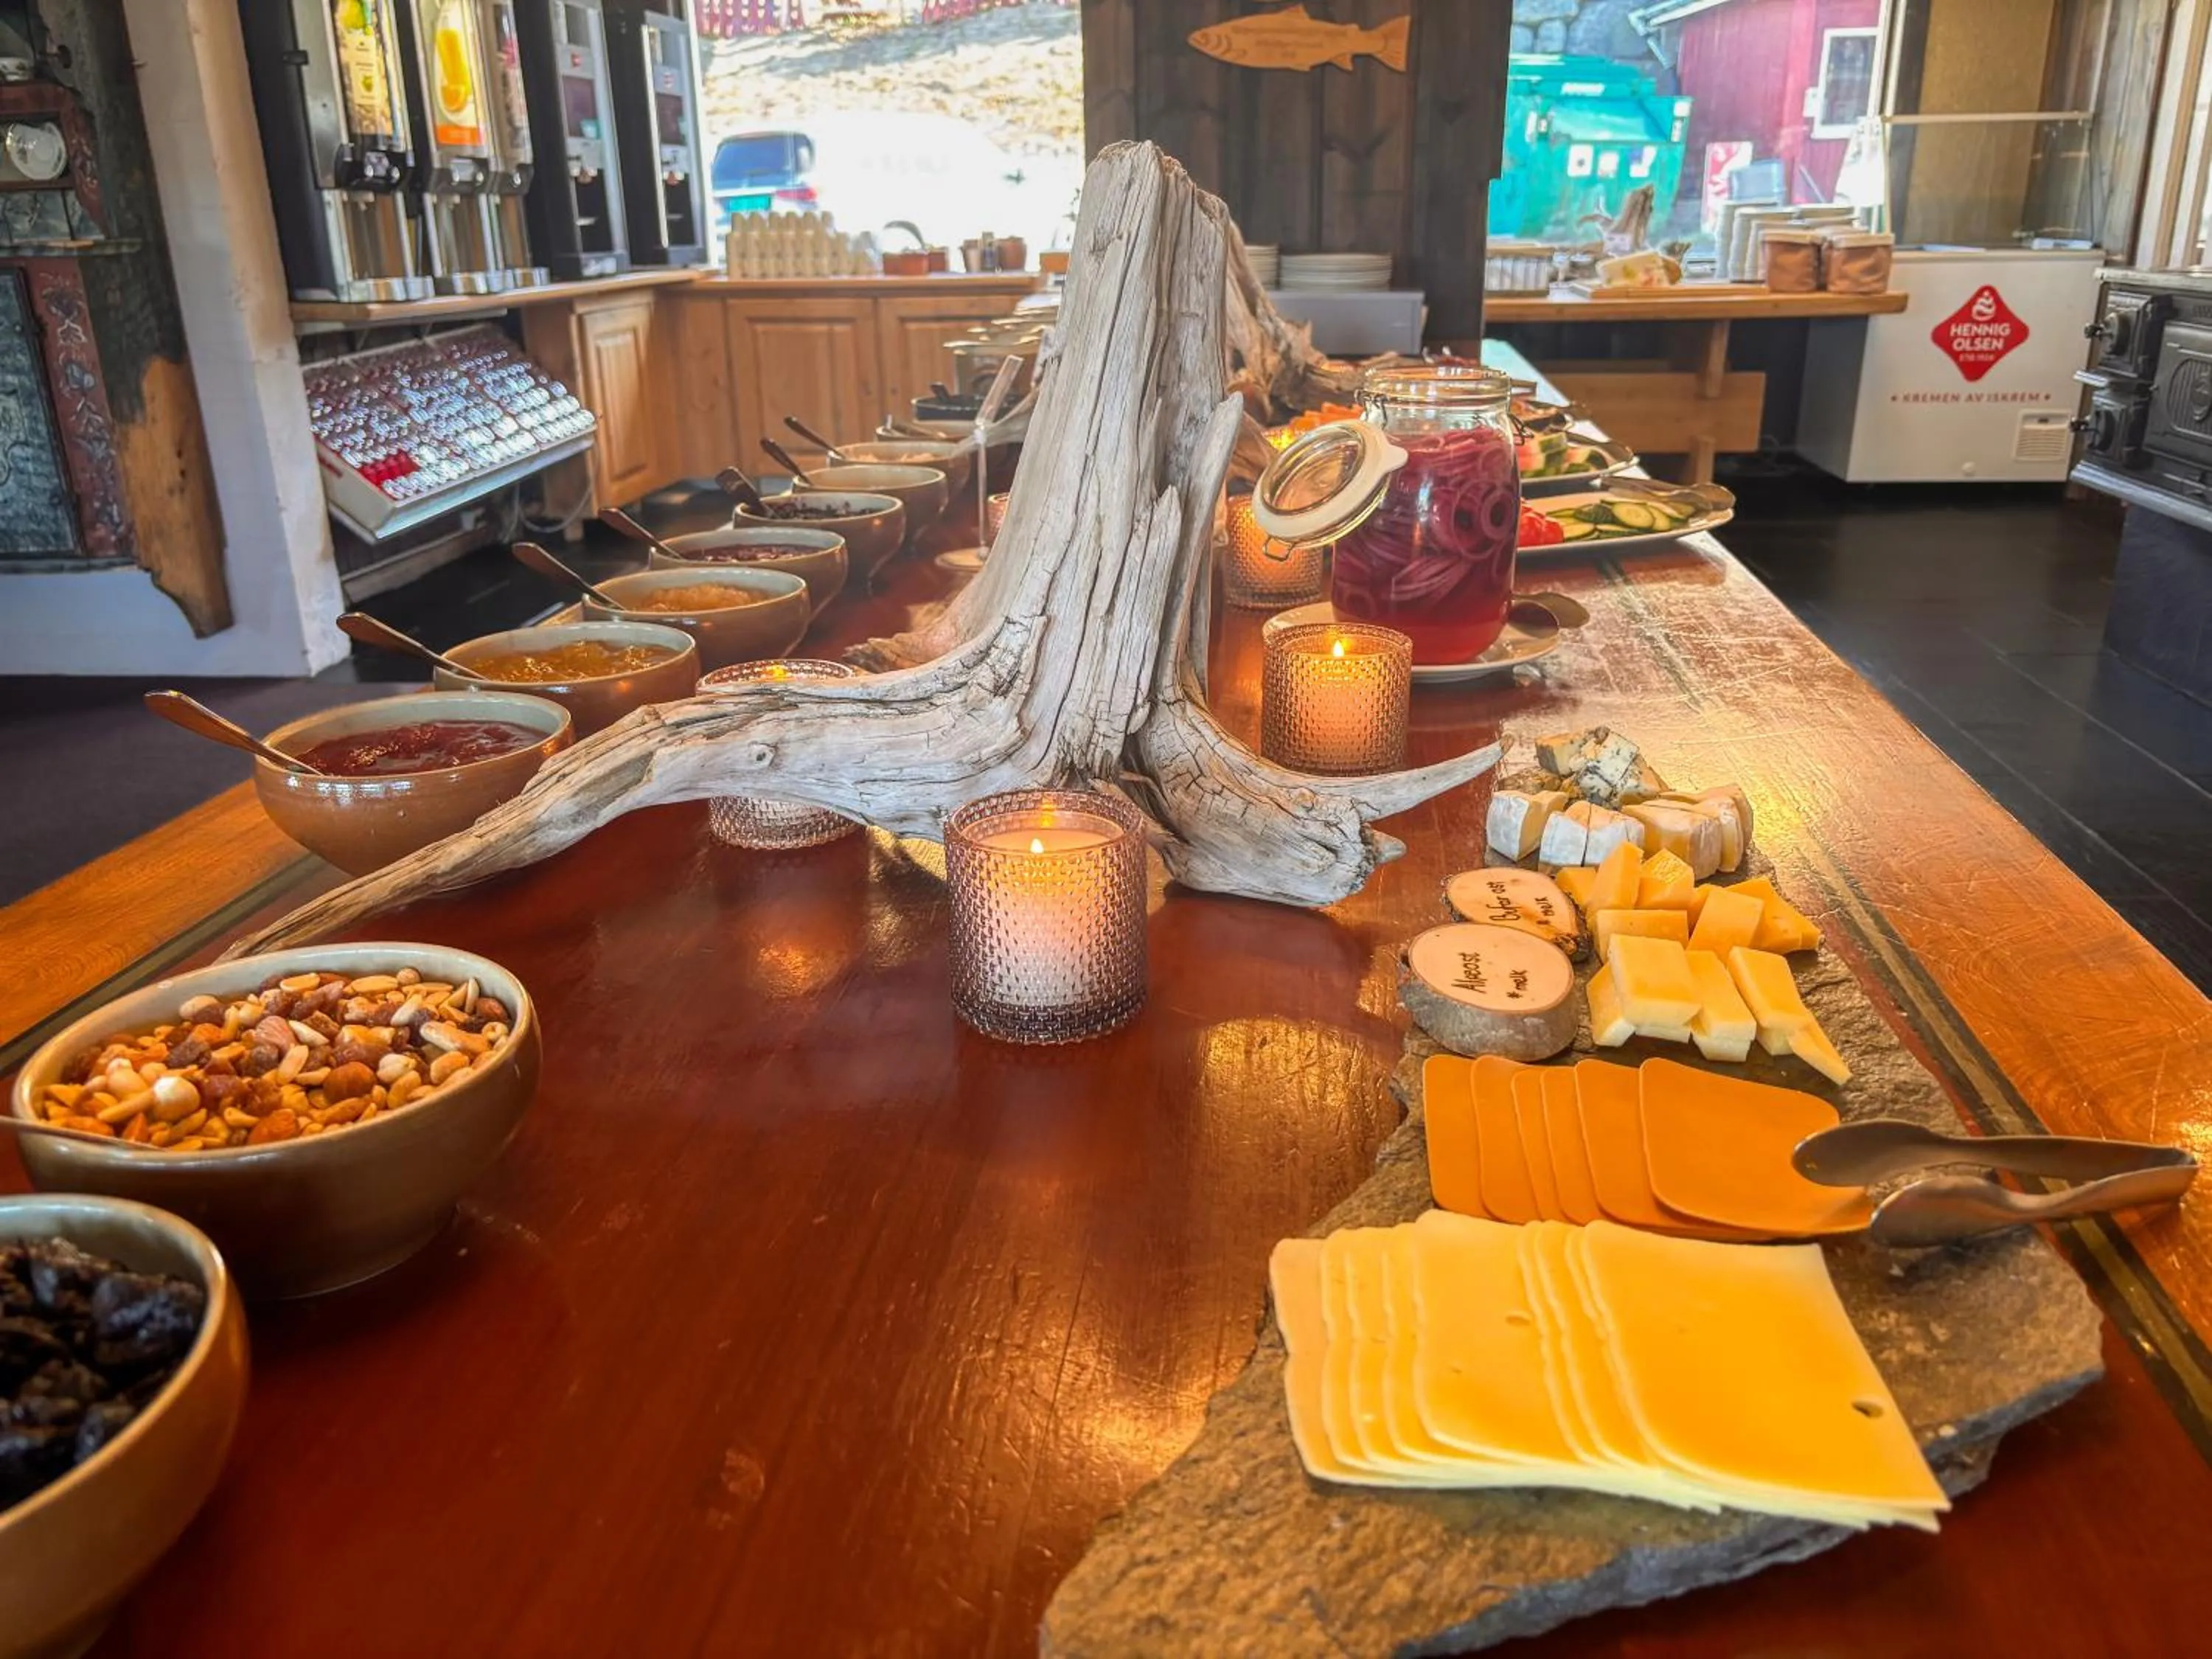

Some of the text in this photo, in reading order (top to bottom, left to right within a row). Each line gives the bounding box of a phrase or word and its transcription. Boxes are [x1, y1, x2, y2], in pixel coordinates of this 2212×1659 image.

[1950, 322, 2011, 337] HENNIG
[1952, 338, 2005, 351] OLSEN
[1902, 392, 2040, 403] KREMEN AV ISKREM
